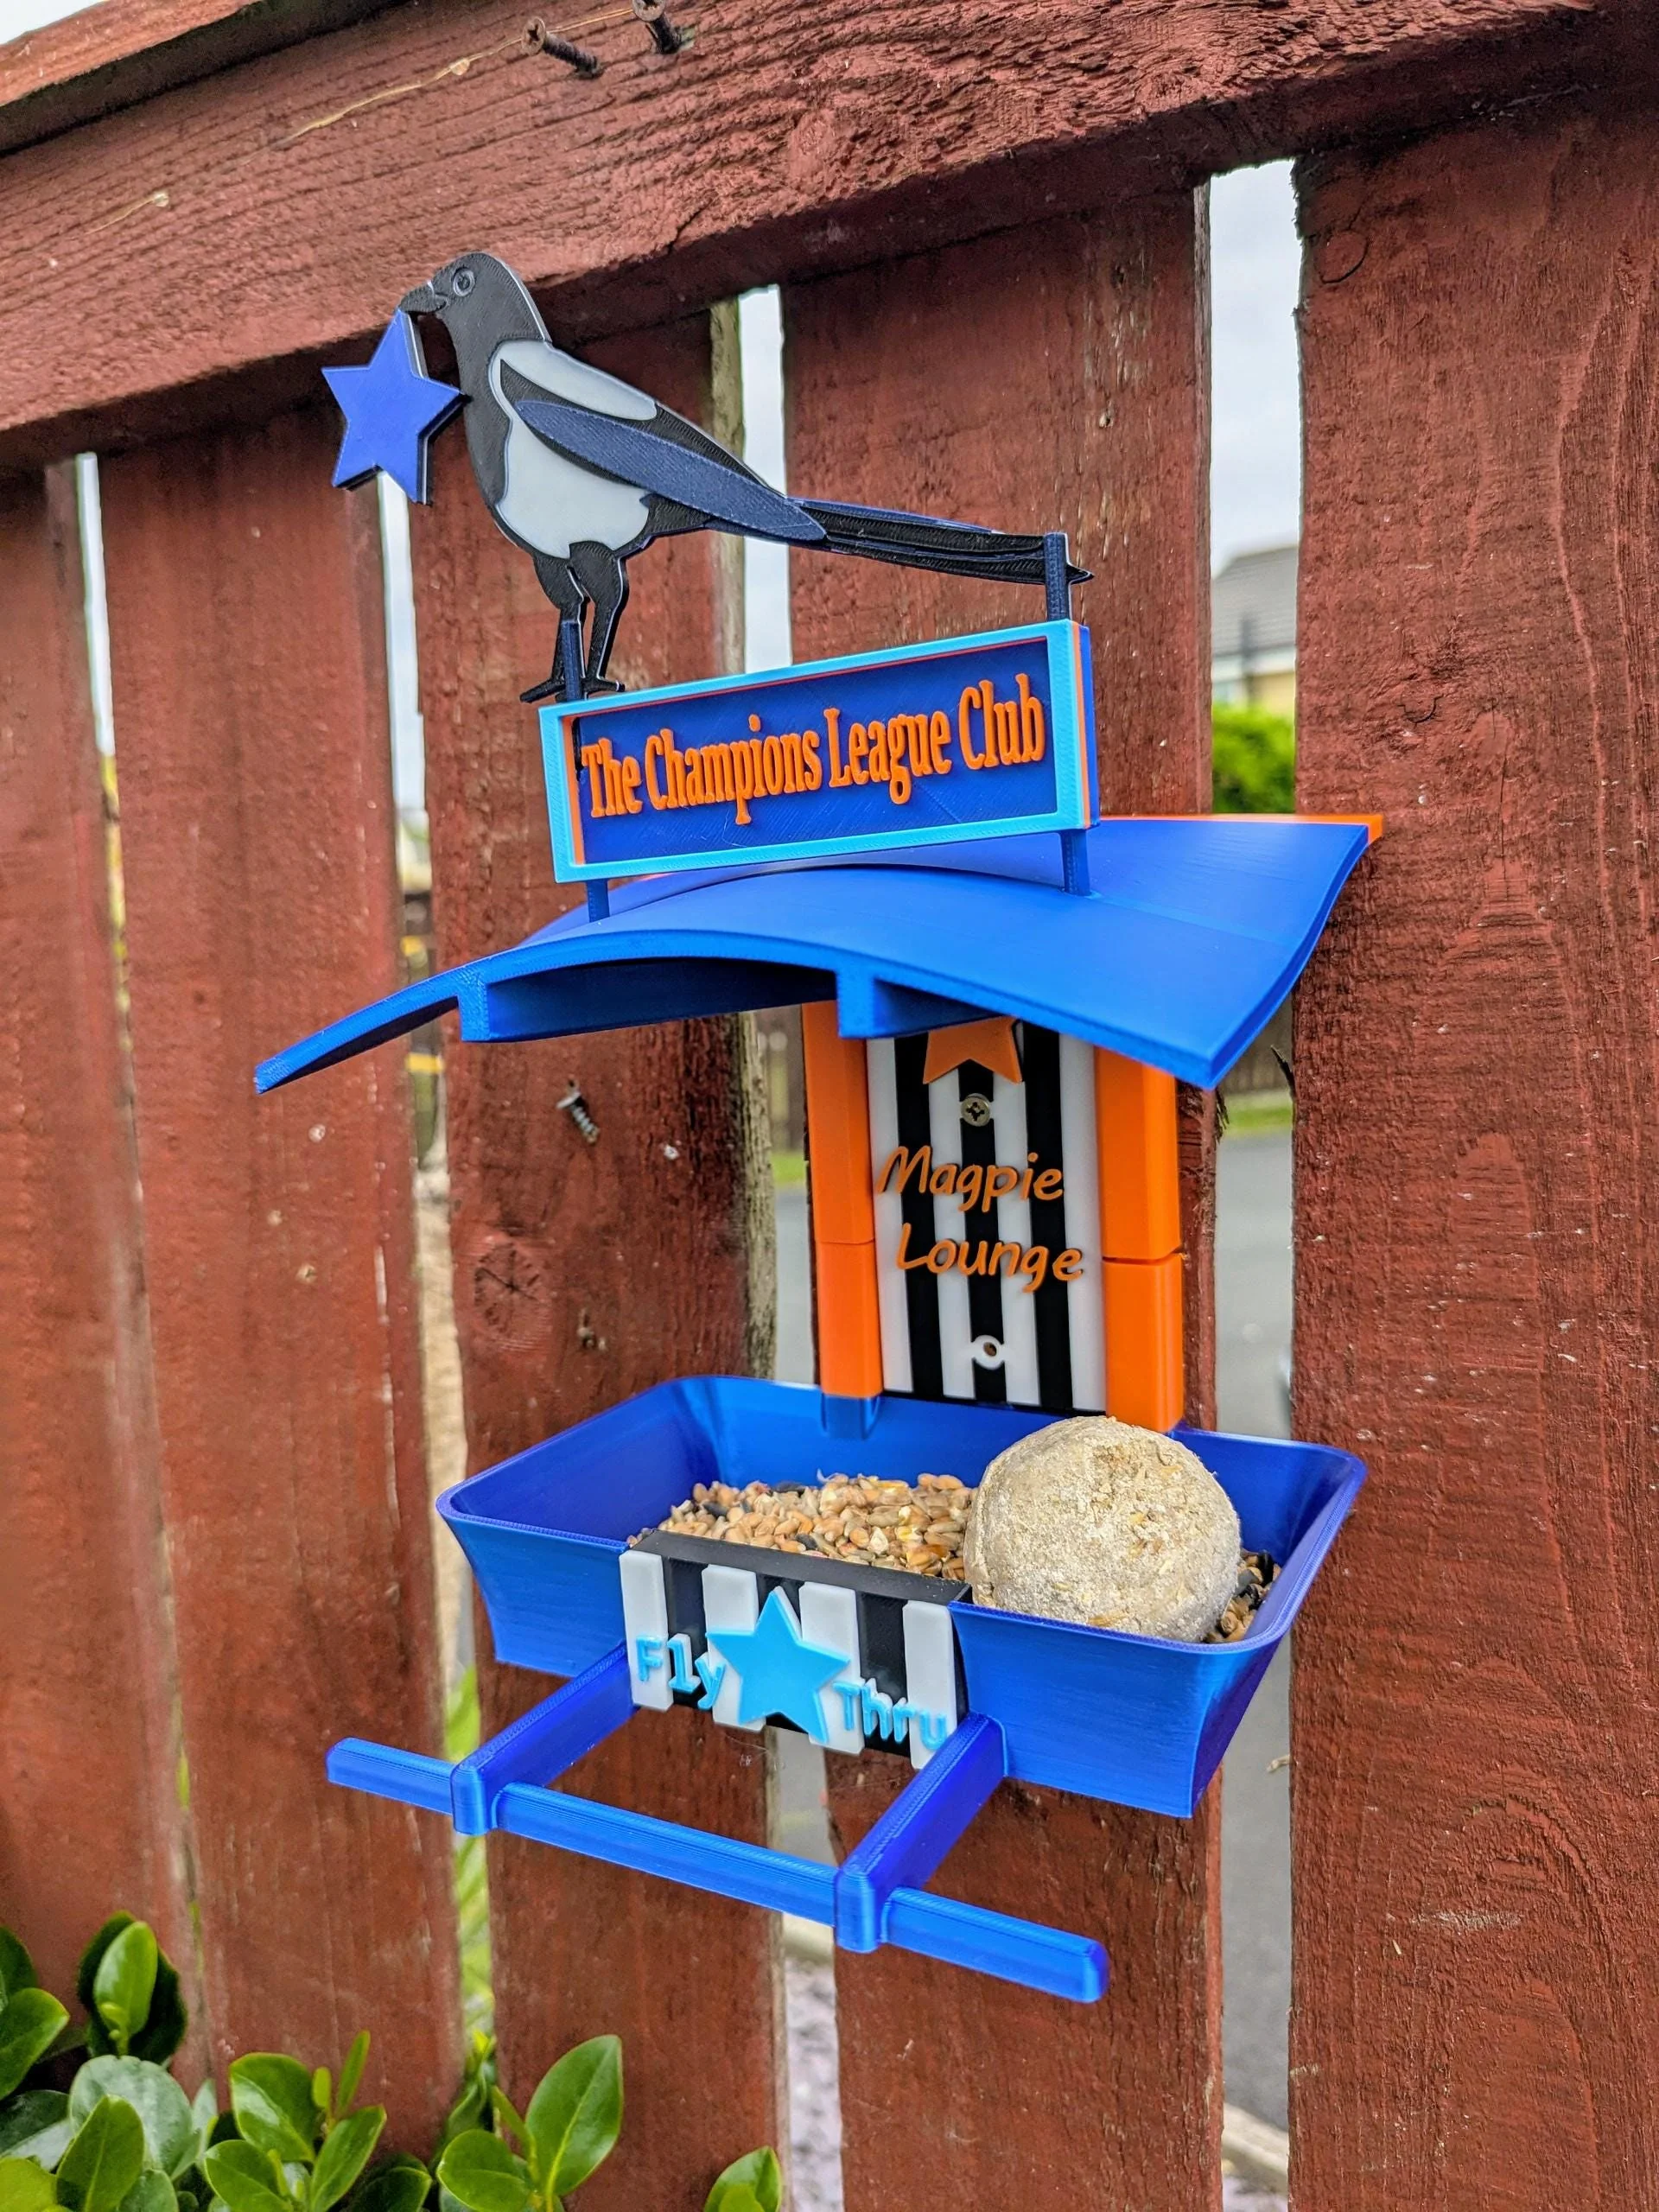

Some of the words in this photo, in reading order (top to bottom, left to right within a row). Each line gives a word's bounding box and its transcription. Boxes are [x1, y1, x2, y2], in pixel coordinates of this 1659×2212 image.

[582, 738, 643, 818] The
[645, 715, 820, 825] Champions
[824, 708, 951, 804] League
[958, 673, 1046, 770] Club
[876, 1145, 1065, 1212] Magpie
[896, 1223, 1084, 1294] Lounge
[636, 1634, 727, 1711] Fly
[832, 1678, 948, 1751] Thru
